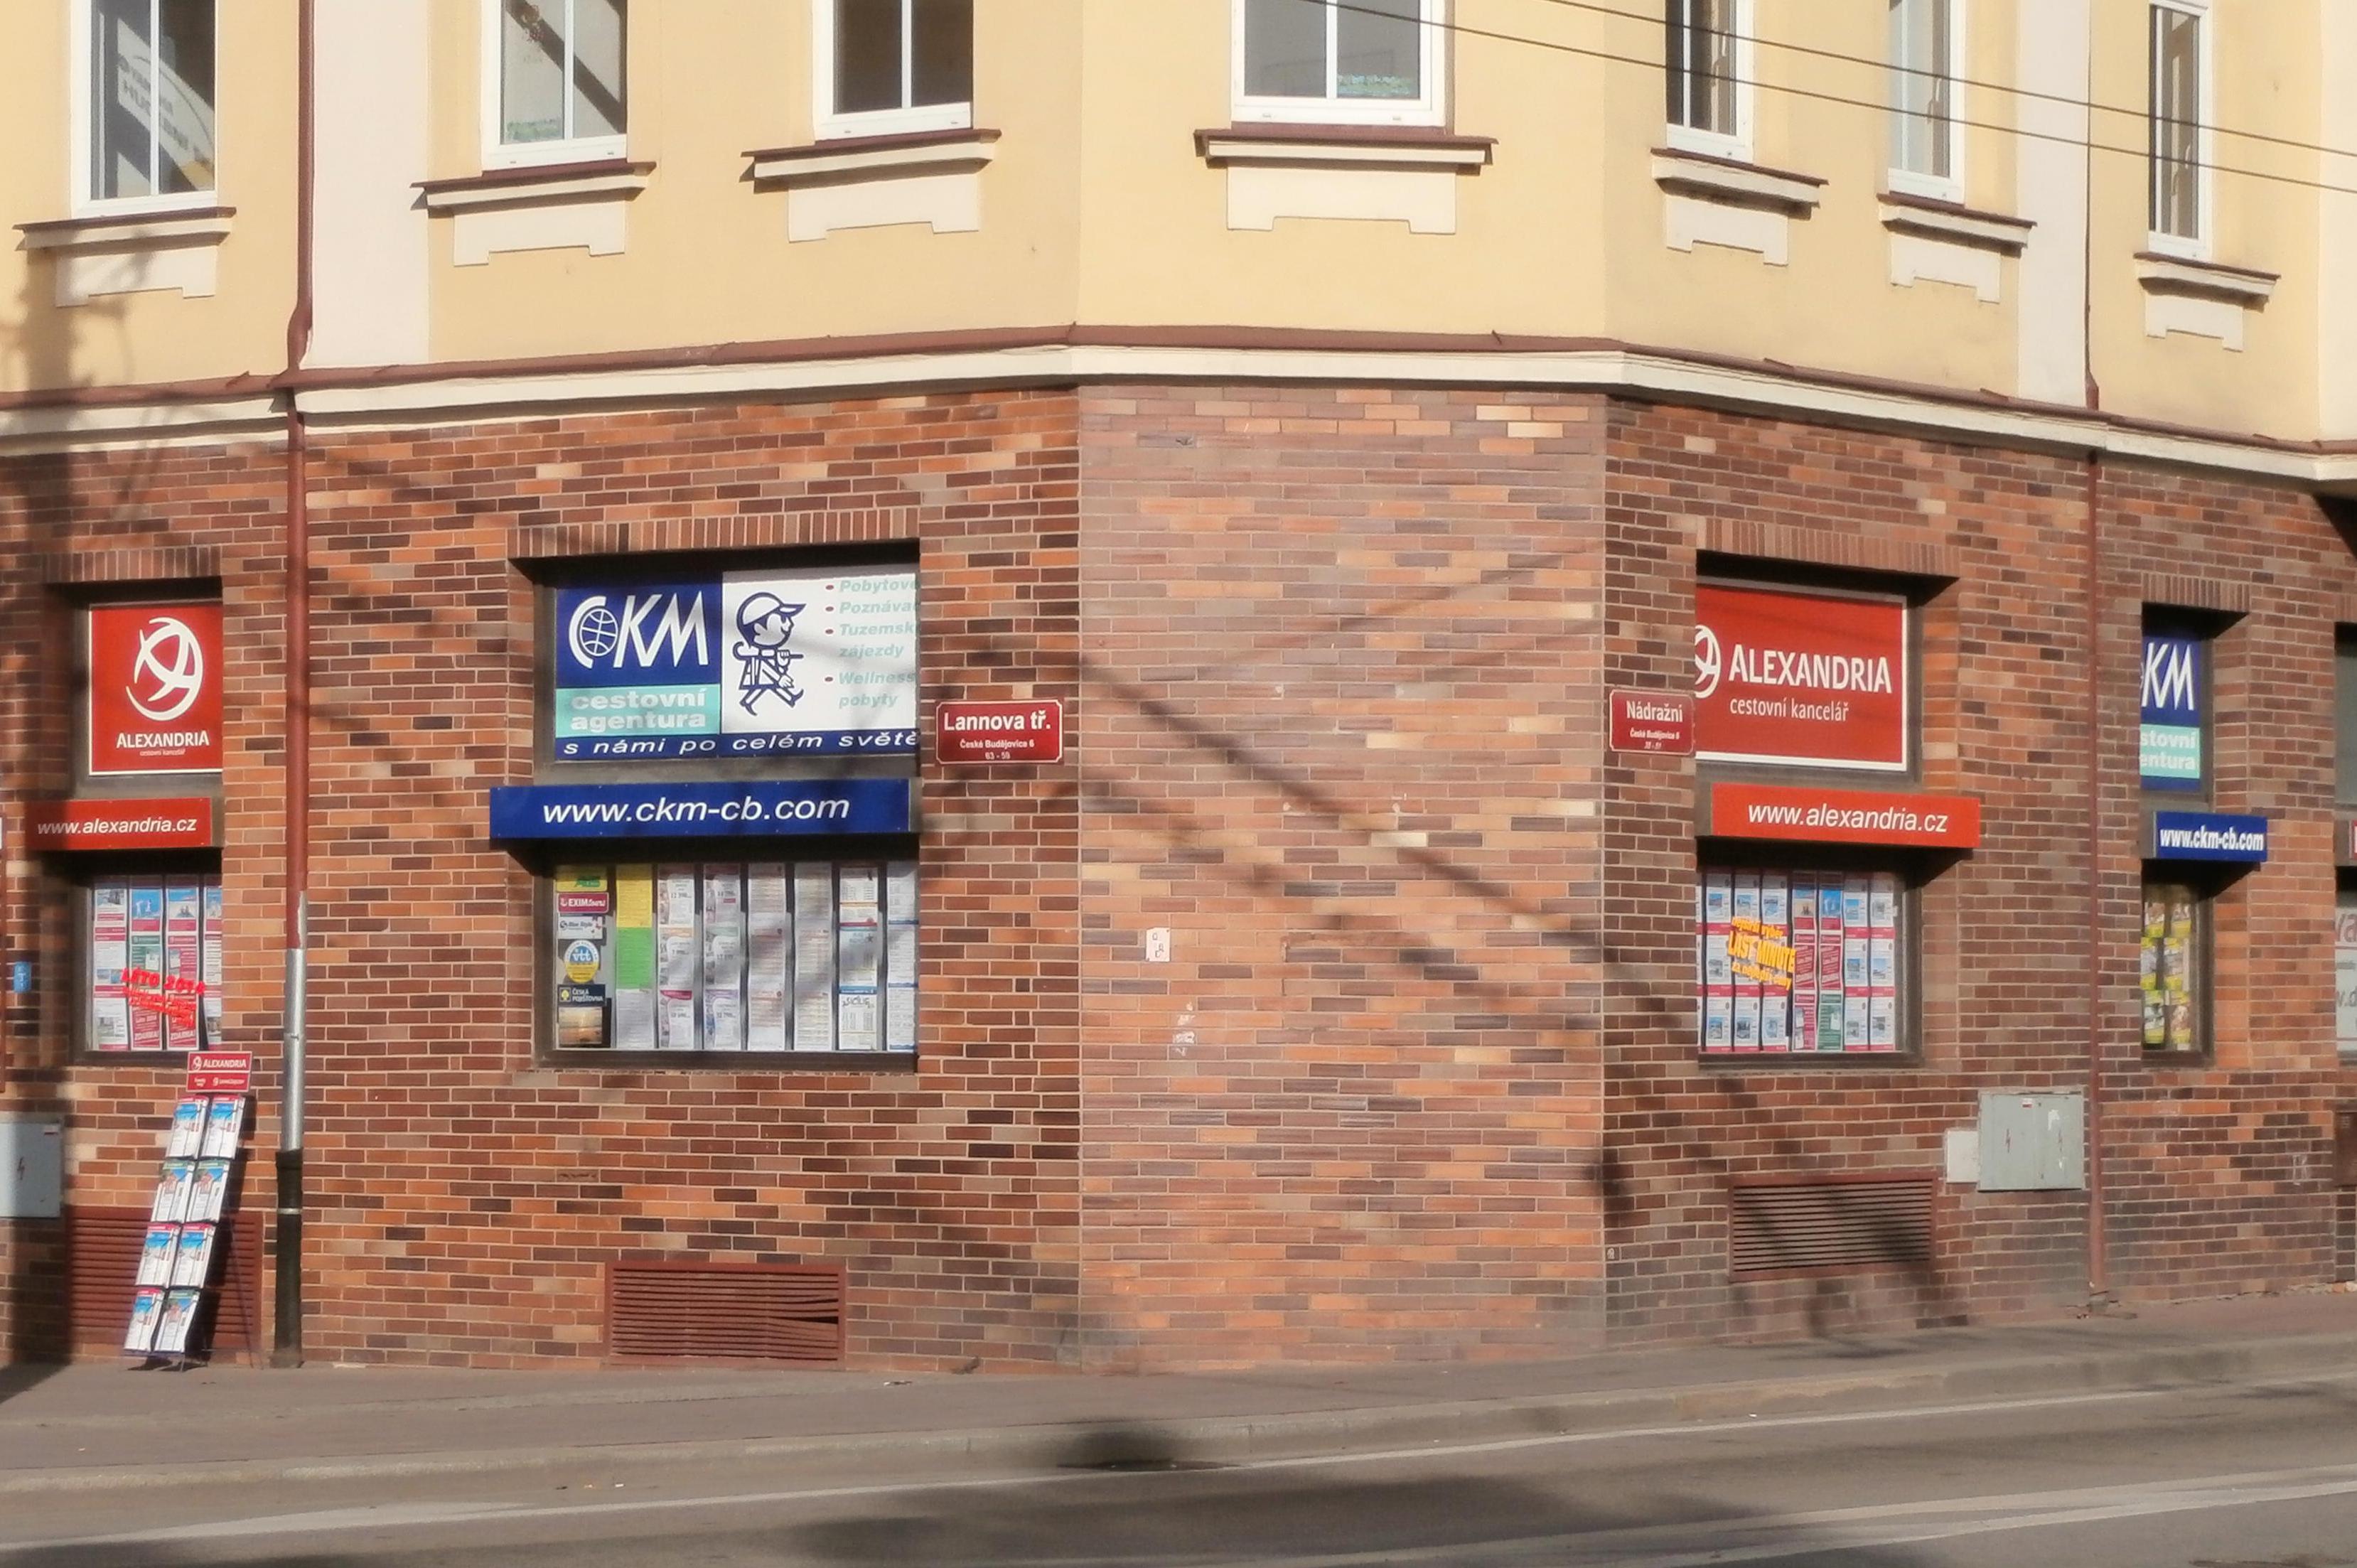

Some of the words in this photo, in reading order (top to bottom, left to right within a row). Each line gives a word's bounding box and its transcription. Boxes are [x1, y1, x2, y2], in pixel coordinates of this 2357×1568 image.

[569, 591, 708, 670] CKM
[840, 621, 918, 637] Tuzemsk
[839, 643, 904, 660] zájezdy
[839, 671, 916, 684] Wellness
[1728, 643, 1893, 694] ALEXANDRIA
[2141, 641, 2194, 711] KM
[570, 687, 707, 711] cestovní
[839, 693, 898, 709] pobyty
[1729, 697, 1788, 718] cestovní
[1791, 700, 1850, 723] kancelář
[570, 710, 707, 734] agentura
[943, 711, 1025, 731] Lannova
[1030, 709, 1051, 731] tř.
[1626, 700, 1683, 723] Nádražní
[116, 730, 210, 748] ALEXANDRIA
[564, 740, 578, 755] s
[593, 736, 665, 755] námi
[680, 738, 716, 756] po
[733, 732, 823, 751] celém
[839, 731, 919, 748] světě
[960, 739, 984, 748] České
[984, 739, 1028, 750] Budějovice
[2139, 730, 2196, 749] stovní
[2139, 753, 2196, 770] entura
[543, 795, 850, 825] www.ckm-cb.com
[1747, 802, 1948, 834] www.alexandria.cz
[37, 815, 198, 836] www.alexandria.cz
[2159, 826, 2265, 854] www.ckm-cb.com
[1728, 930, 1760, 961] LAST
[1756, 940, 1798, 973] MINUTE
[203, 1058, 247, 1068] ALEXANDRIA
